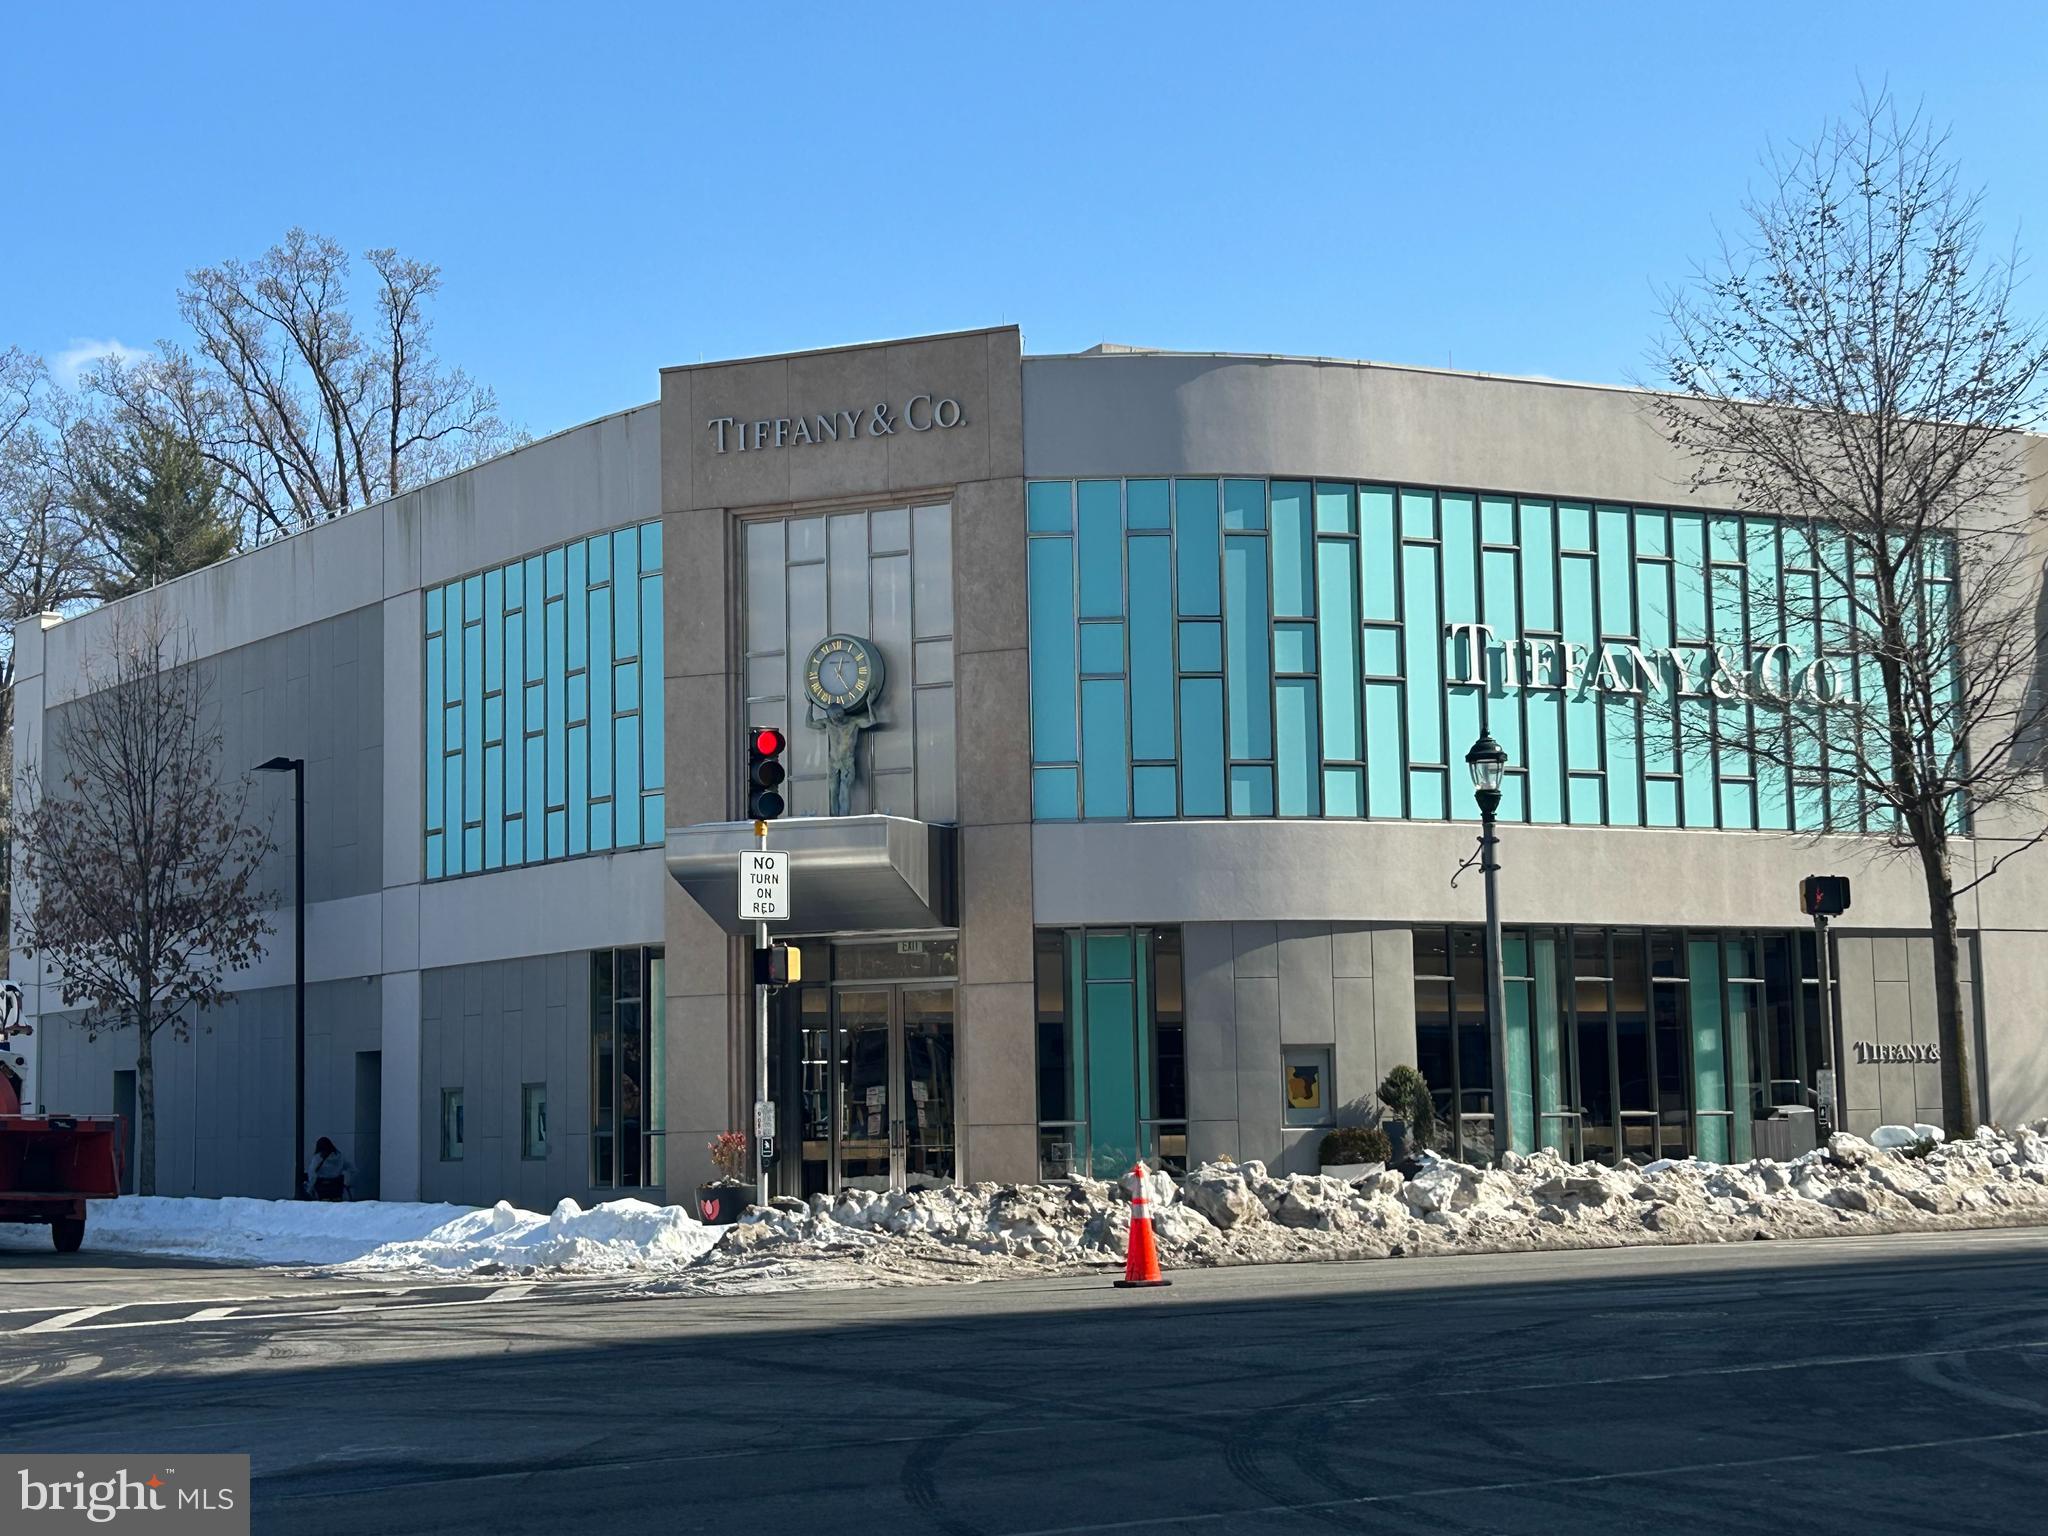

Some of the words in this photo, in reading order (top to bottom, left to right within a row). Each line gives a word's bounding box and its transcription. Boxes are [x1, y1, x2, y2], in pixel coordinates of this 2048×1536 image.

[707, 408, 864, 454] TIFFANY
[868, 402, 896, 437] &
[753, 856, 775, 869] NO
[750, 873, 779, 884] TURN
[756, 888, 772, 898] ON
[753, 902, 776, 913] RED
